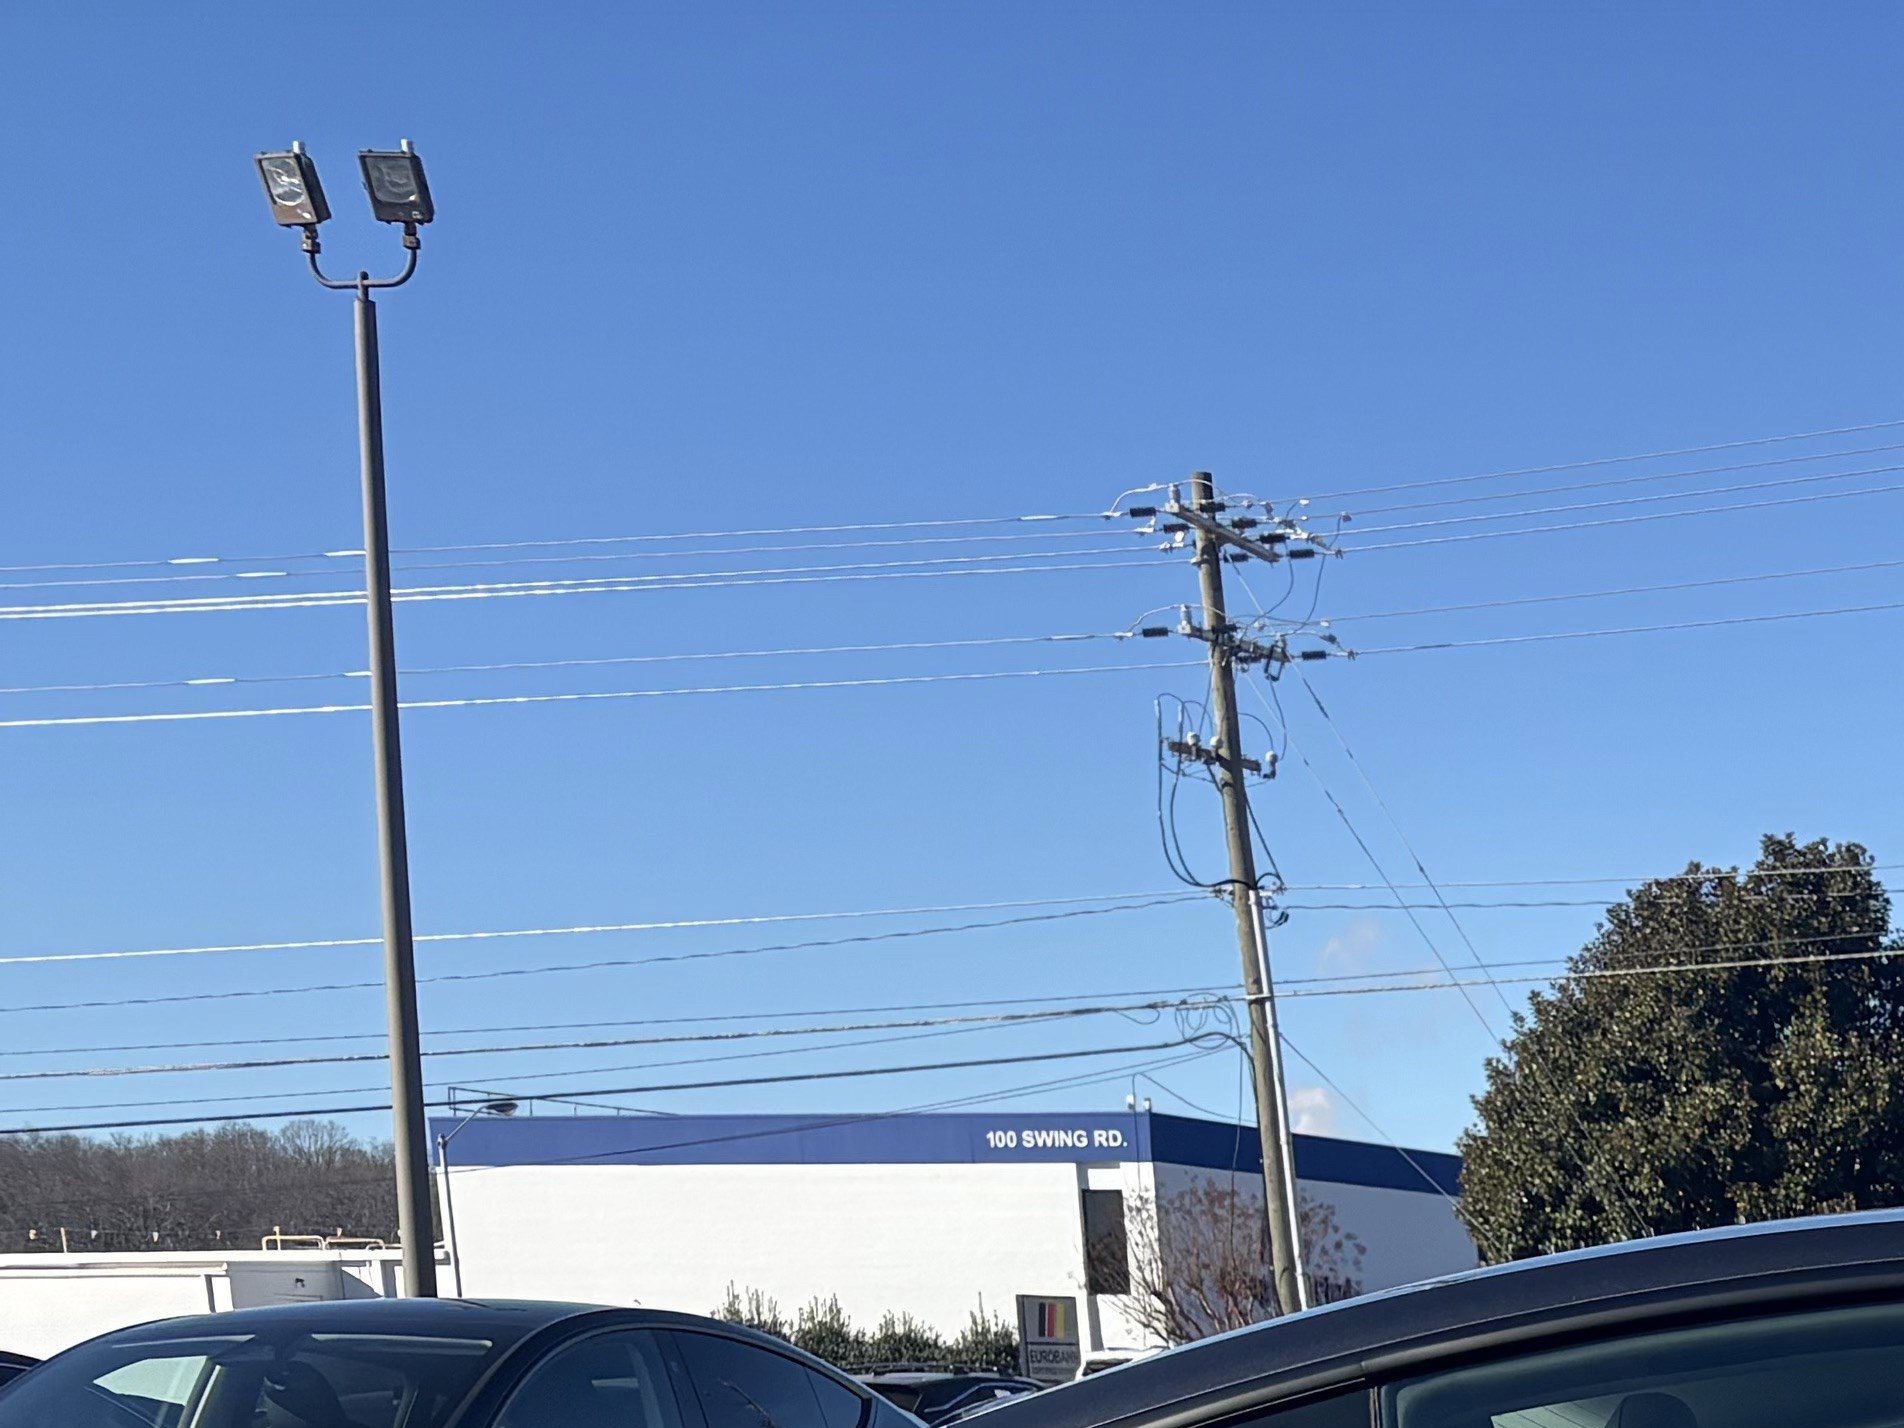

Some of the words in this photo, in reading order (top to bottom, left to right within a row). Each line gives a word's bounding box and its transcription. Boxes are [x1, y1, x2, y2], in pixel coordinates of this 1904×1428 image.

[986, 1130, 1018, 1148] 100
[1021, 1129, 1089, 1148] SWING
[1093, 1129, 1128, 1148] RD.
